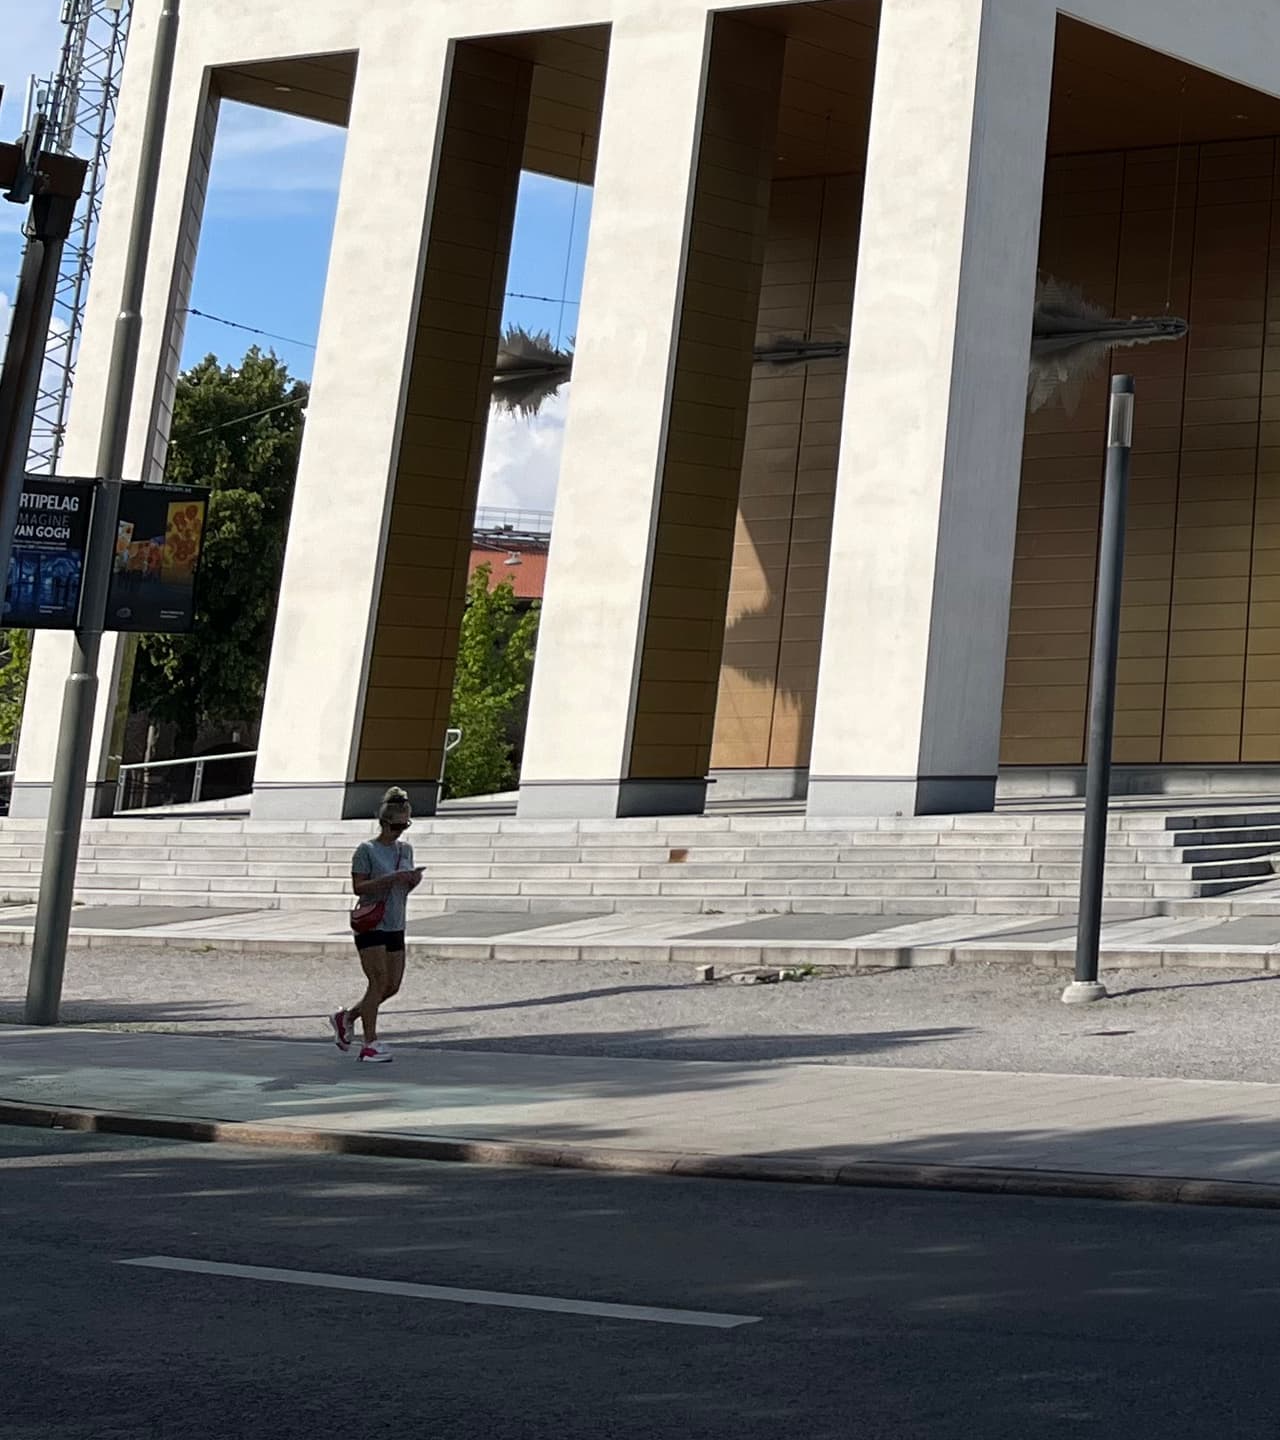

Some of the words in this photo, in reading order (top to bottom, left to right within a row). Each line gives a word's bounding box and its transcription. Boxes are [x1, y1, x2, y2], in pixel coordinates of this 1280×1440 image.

[19, 493, 80, 512] RTIPELAG
[18, 513, 71, 527] MAGINE
[35, 526, 71, 539] GOGH
